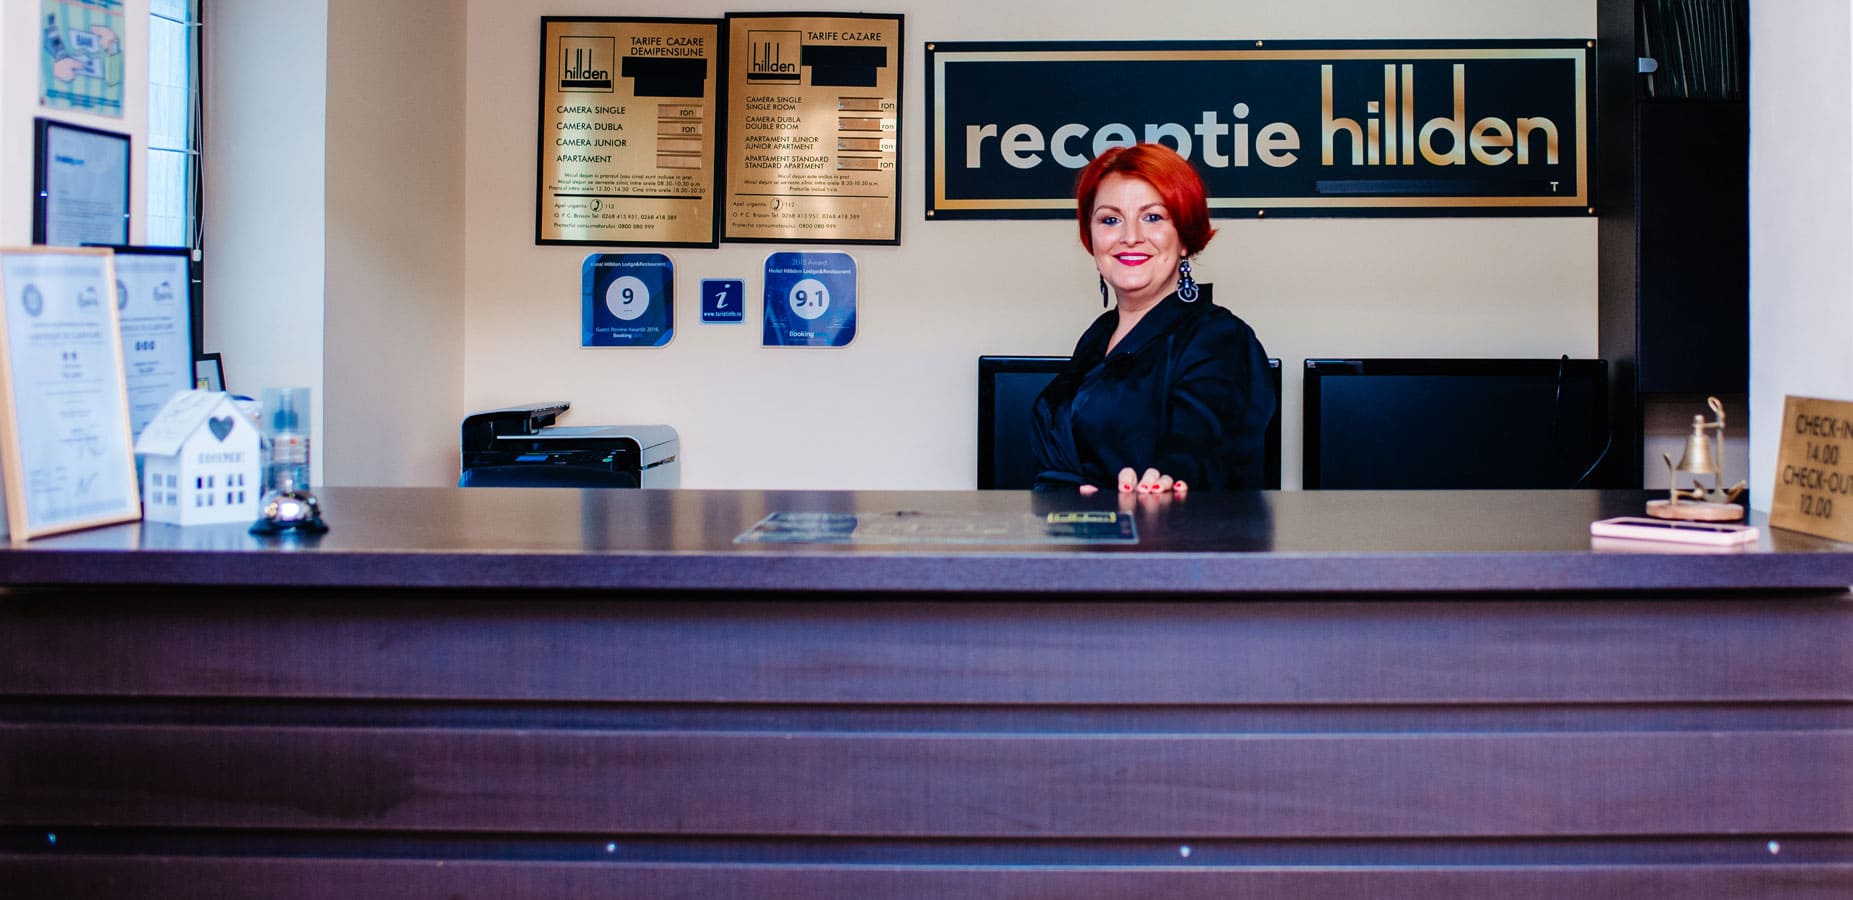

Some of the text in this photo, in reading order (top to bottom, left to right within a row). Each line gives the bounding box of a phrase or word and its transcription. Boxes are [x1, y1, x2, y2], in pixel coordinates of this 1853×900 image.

[631, 36, 704, 46] TARIFE CAZARE
[808, 32, 882, 42] TARIFE CAZARE
[630, 47, 704, 57] DEMIPENSIUNE
[753, 42, 796, 72] hillden
[564, 48, 608, 80] hillden
[746, 96, 776, 104] CAMERA
[880, 102, 895, 110] ron
[556, 106, 694, 116] CAMERA SINGLE ron
[1320, 63, 1560, 166] hillden
[556, 122, 696, 133] CAMERA DUBLA ron
[556, 138, 627, 148] CAMERA JUNIOR
[556, 154, 612, 163] APARTAMENT
[880, 161, 894, 169] ron
[622, 288, 634, 305] 9
[794, 290, 824, 307] 9.1
[1796, 414, 1853, 439] CHECK-IN
[1806, 442, 1839, 466] 14.00
[1800, 494, 1832, 519] 12.00
